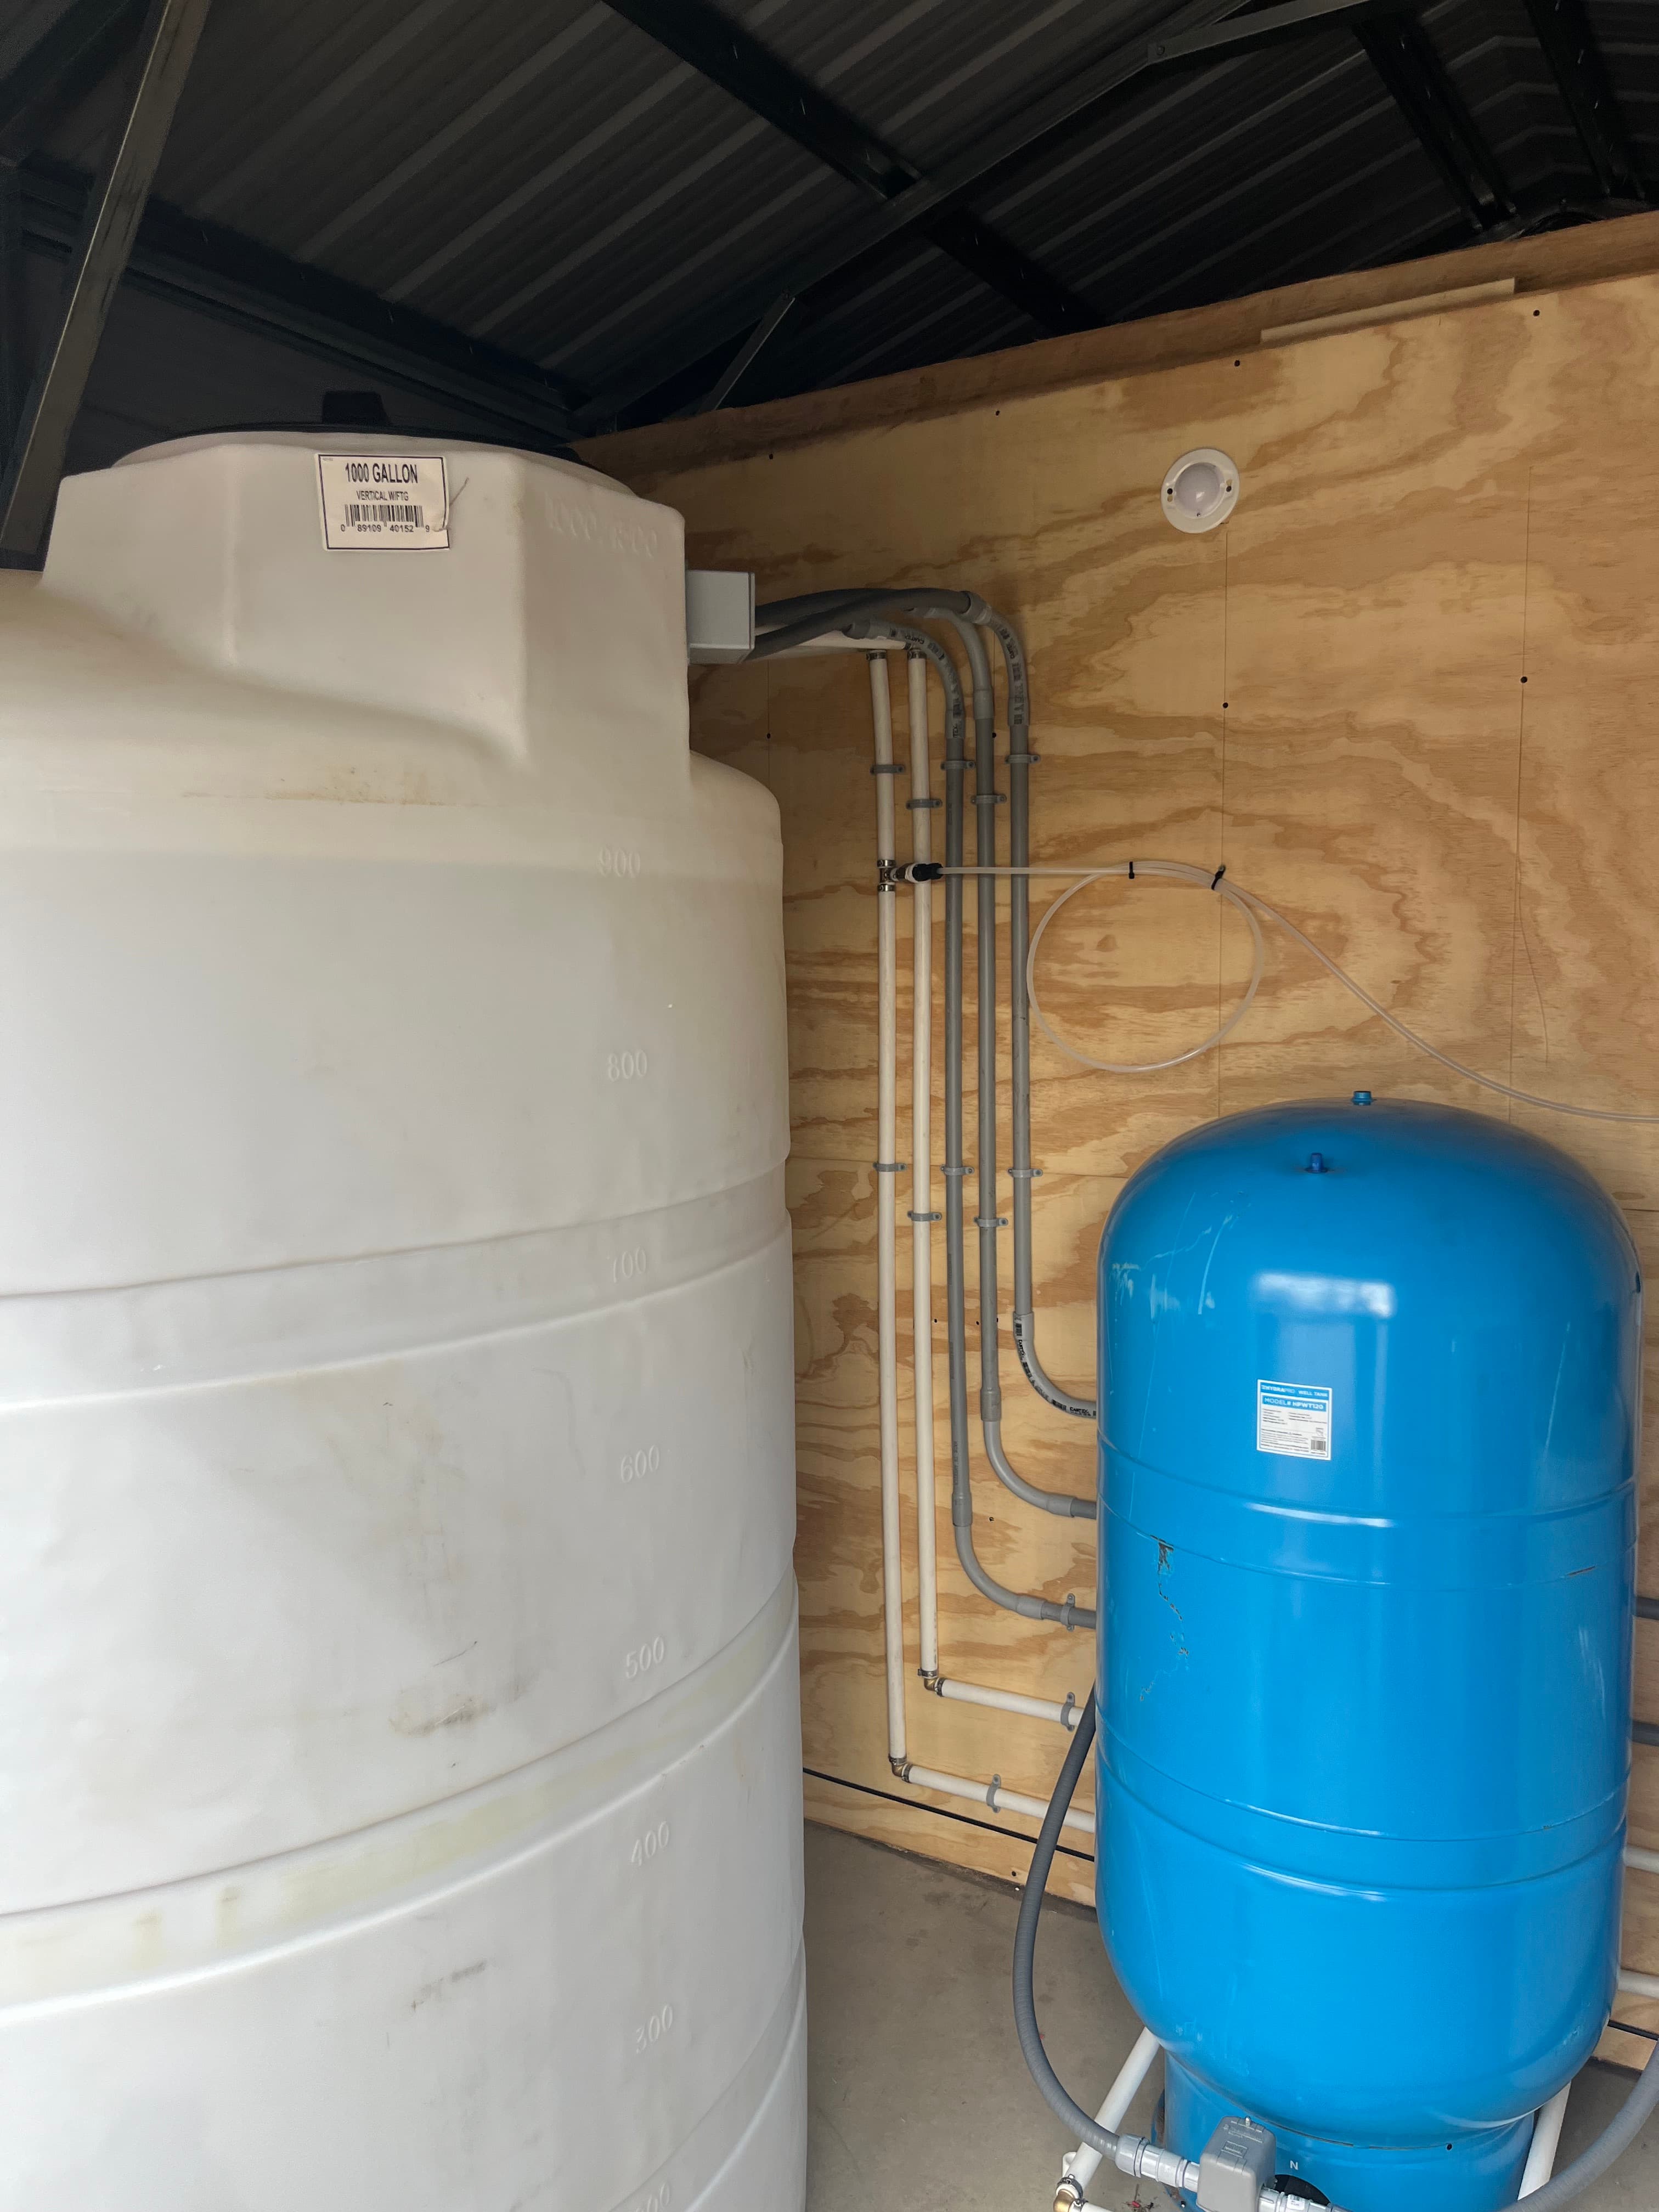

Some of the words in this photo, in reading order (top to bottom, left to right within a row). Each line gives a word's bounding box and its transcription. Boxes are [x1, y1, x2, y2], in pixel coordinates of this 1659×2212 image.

[345, 462, 369, 483] 1000
[372, 463, 418, 483] GALLON
[356, 490, 388, 501] VERTICAL
[599, 845, 641, 878] 900
[607, 1048, 648, 1082] 800
[620, 1444, 660, 1483] 600
[625, 1635, 665, 1679] 500
[630, 1820, 670, 1866] 400
[635, 2004, 674, 2055] 300
[1290, 2160, 1299, 2170] N
[635, 2181, 671, 2212] 00
